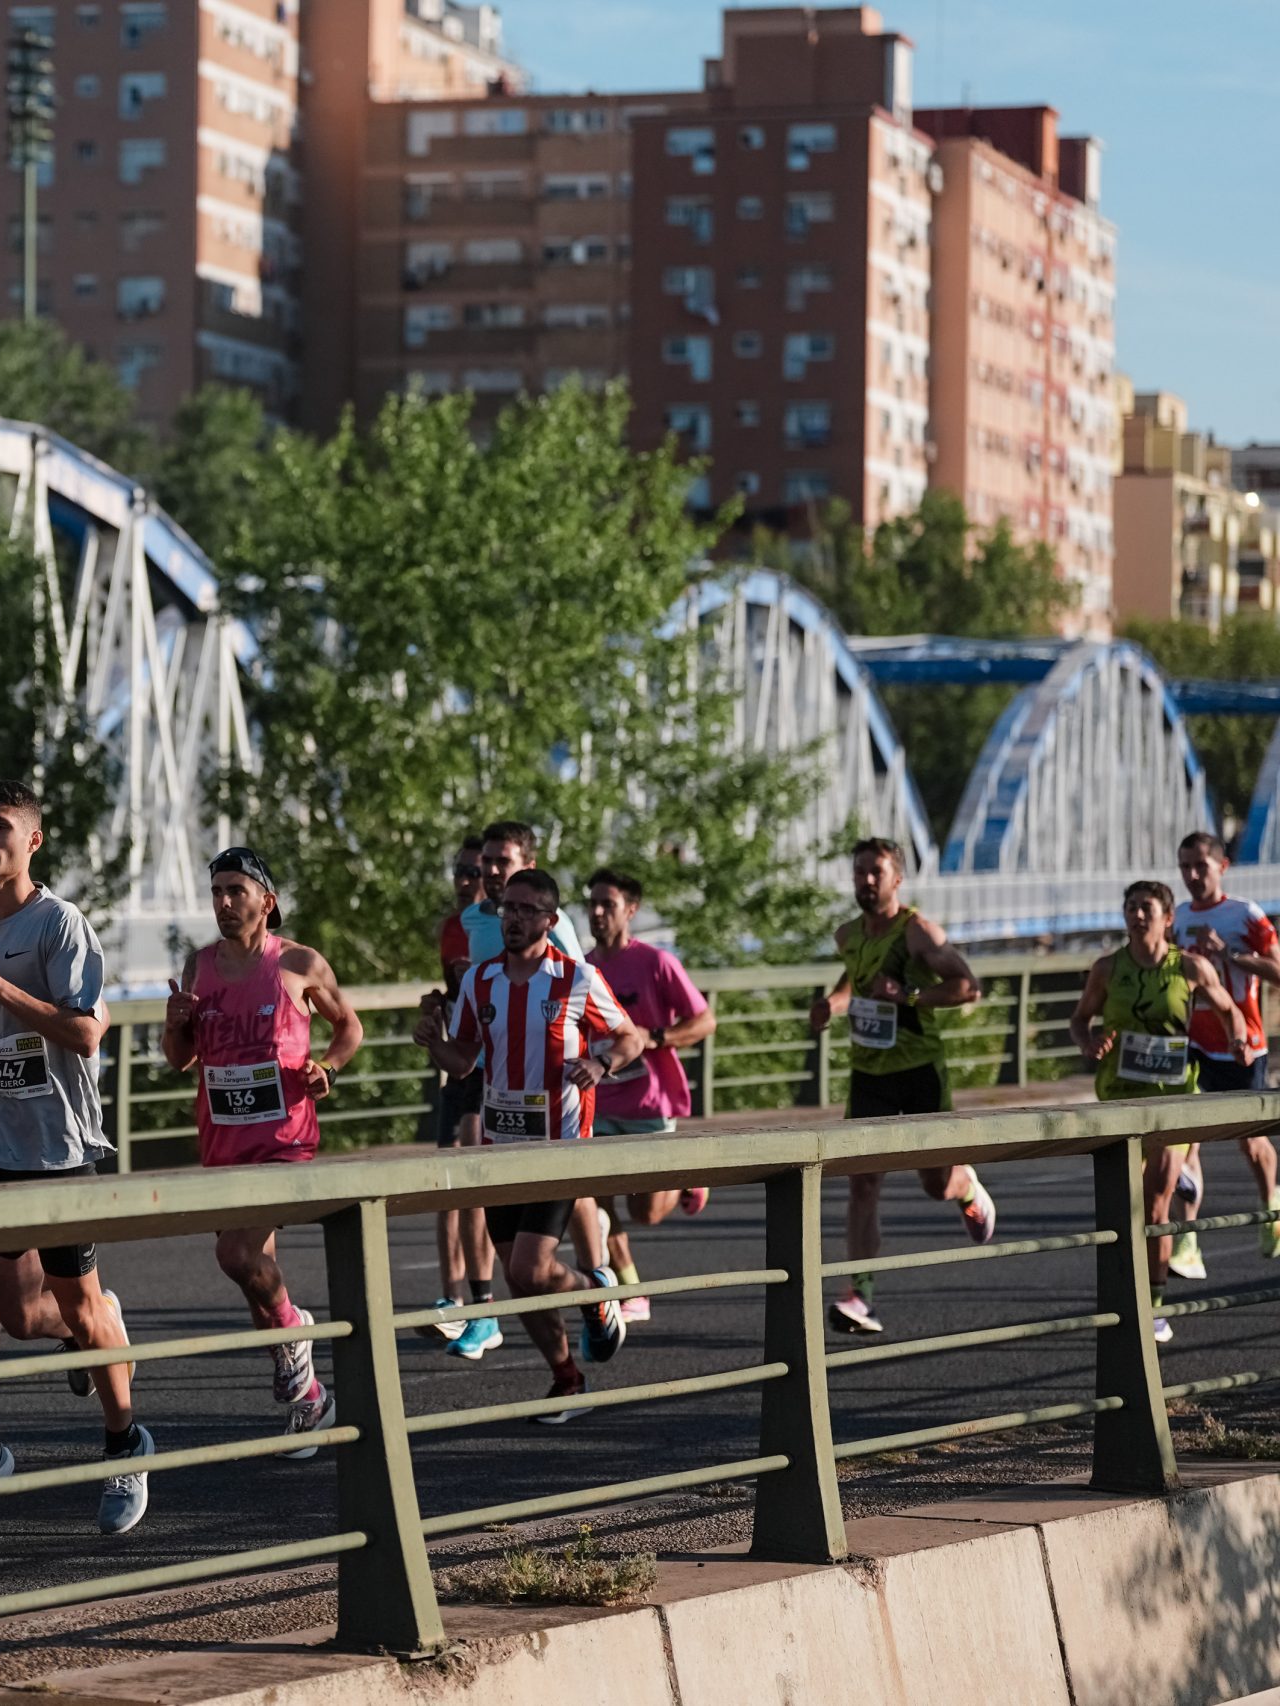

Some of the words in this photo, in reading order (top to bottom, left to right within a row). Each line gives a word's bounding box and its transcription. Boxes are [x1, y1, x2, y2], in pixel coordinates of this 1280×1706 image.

[17, 1037, 40, 1045] MANN
[225, 1089, 256, 1107] 136
[233, 1106, 250, 1114] ERIC
[496, 1112, 526, 1128] 233
